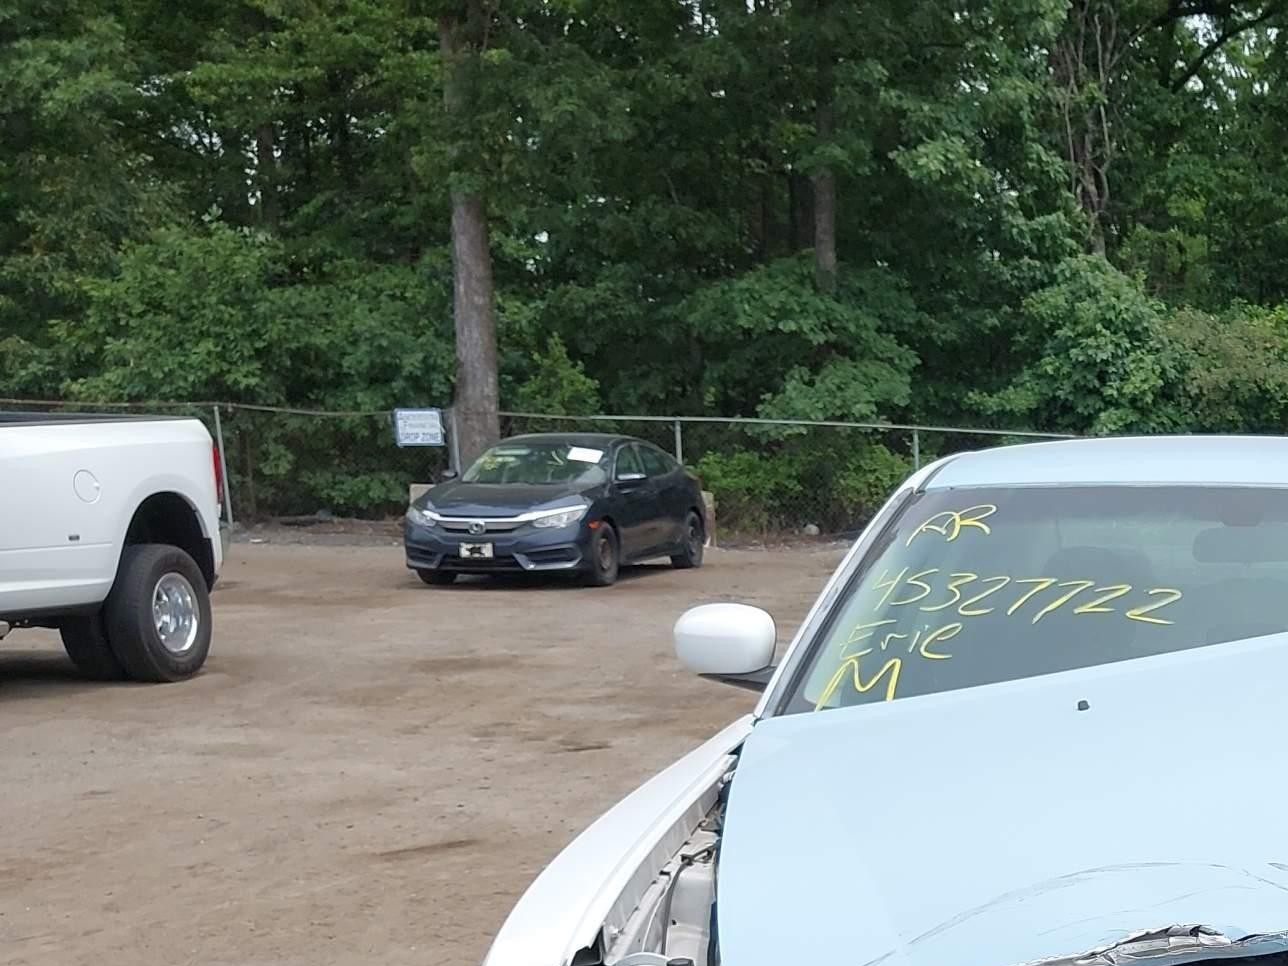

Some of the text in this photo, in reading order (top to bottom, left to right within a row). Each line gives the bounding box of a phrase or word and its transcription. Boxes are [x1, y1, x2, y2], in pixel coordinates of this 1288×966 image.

[872, 566, 1183, 625] 45327722
[840, 620, 963, 661] Erie
[814, 657, 902, 711] M
